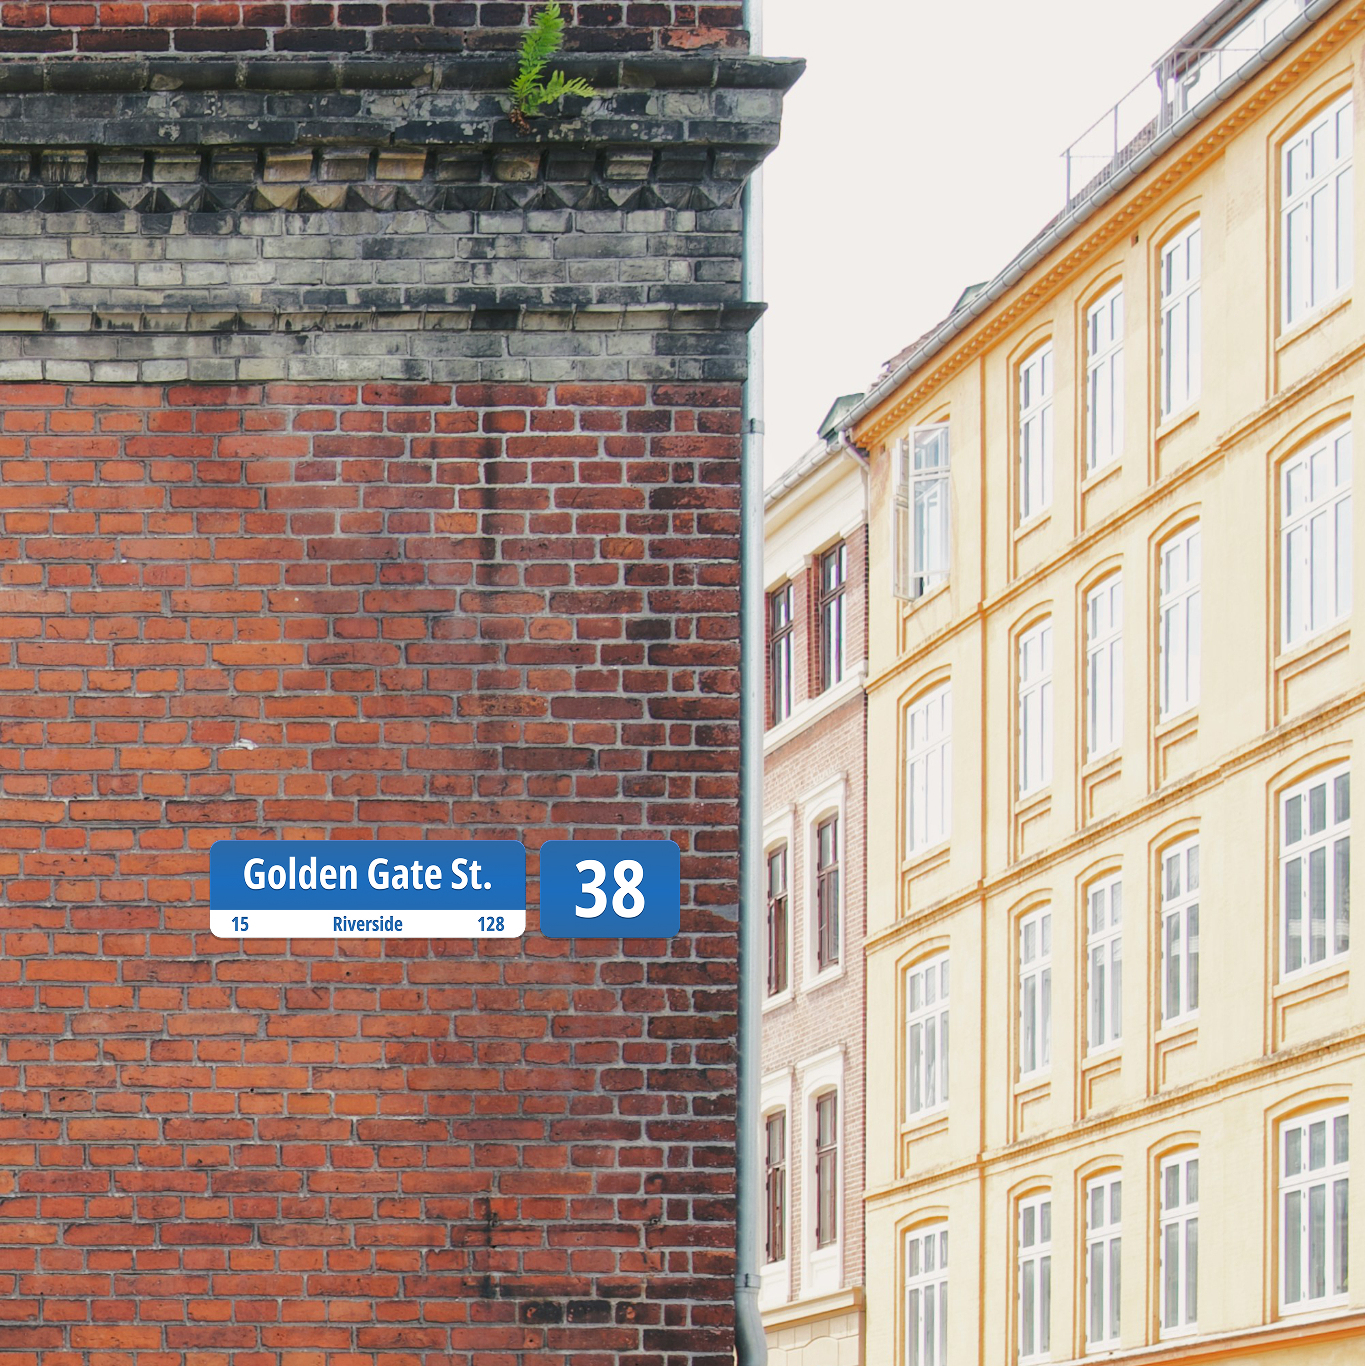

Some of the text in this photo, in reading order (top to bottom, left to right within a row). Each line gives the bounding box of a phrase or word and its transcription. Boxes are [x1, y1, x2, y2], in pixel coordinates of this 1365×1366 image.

[243, 856, 492, 890] Golden Gate St.
[574, 859, 646, 919] 38
[231, 916, 249, 932] 15
[333, 915, 403, 932] Riverside
[477, 916, 505, 932] 128
